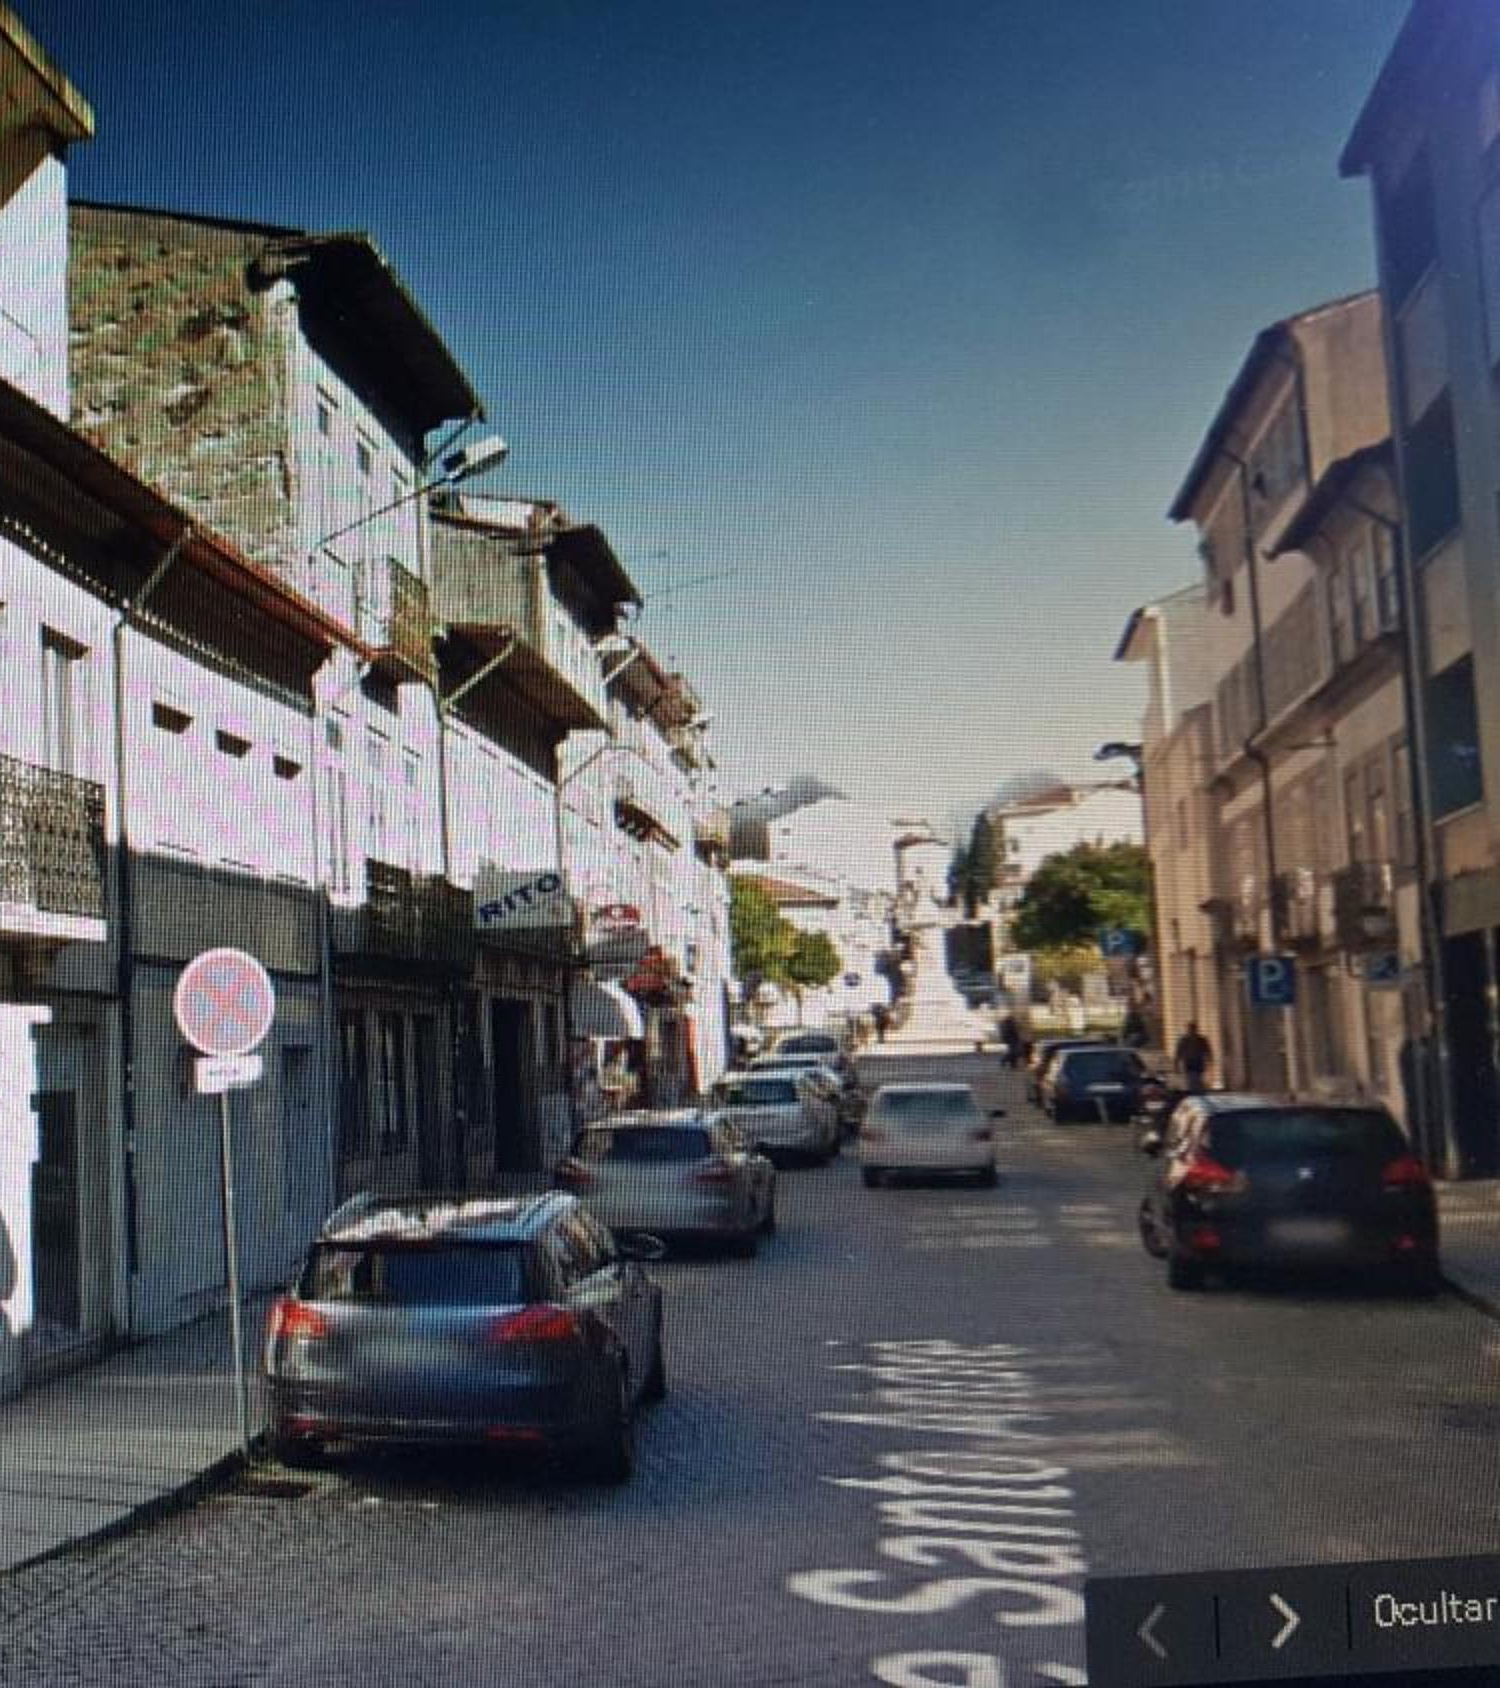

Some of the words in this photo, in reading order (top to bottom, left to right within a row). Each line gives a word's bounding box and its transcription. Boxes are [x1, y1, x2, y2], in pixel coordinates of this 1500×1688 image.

[479, 873, 560, 922] RITO
[1258, 958, 1286, 1000] P
[788, 1452, 1086, 1625] Santo
[1375, 1590, 1498, 1627] Ocultar
